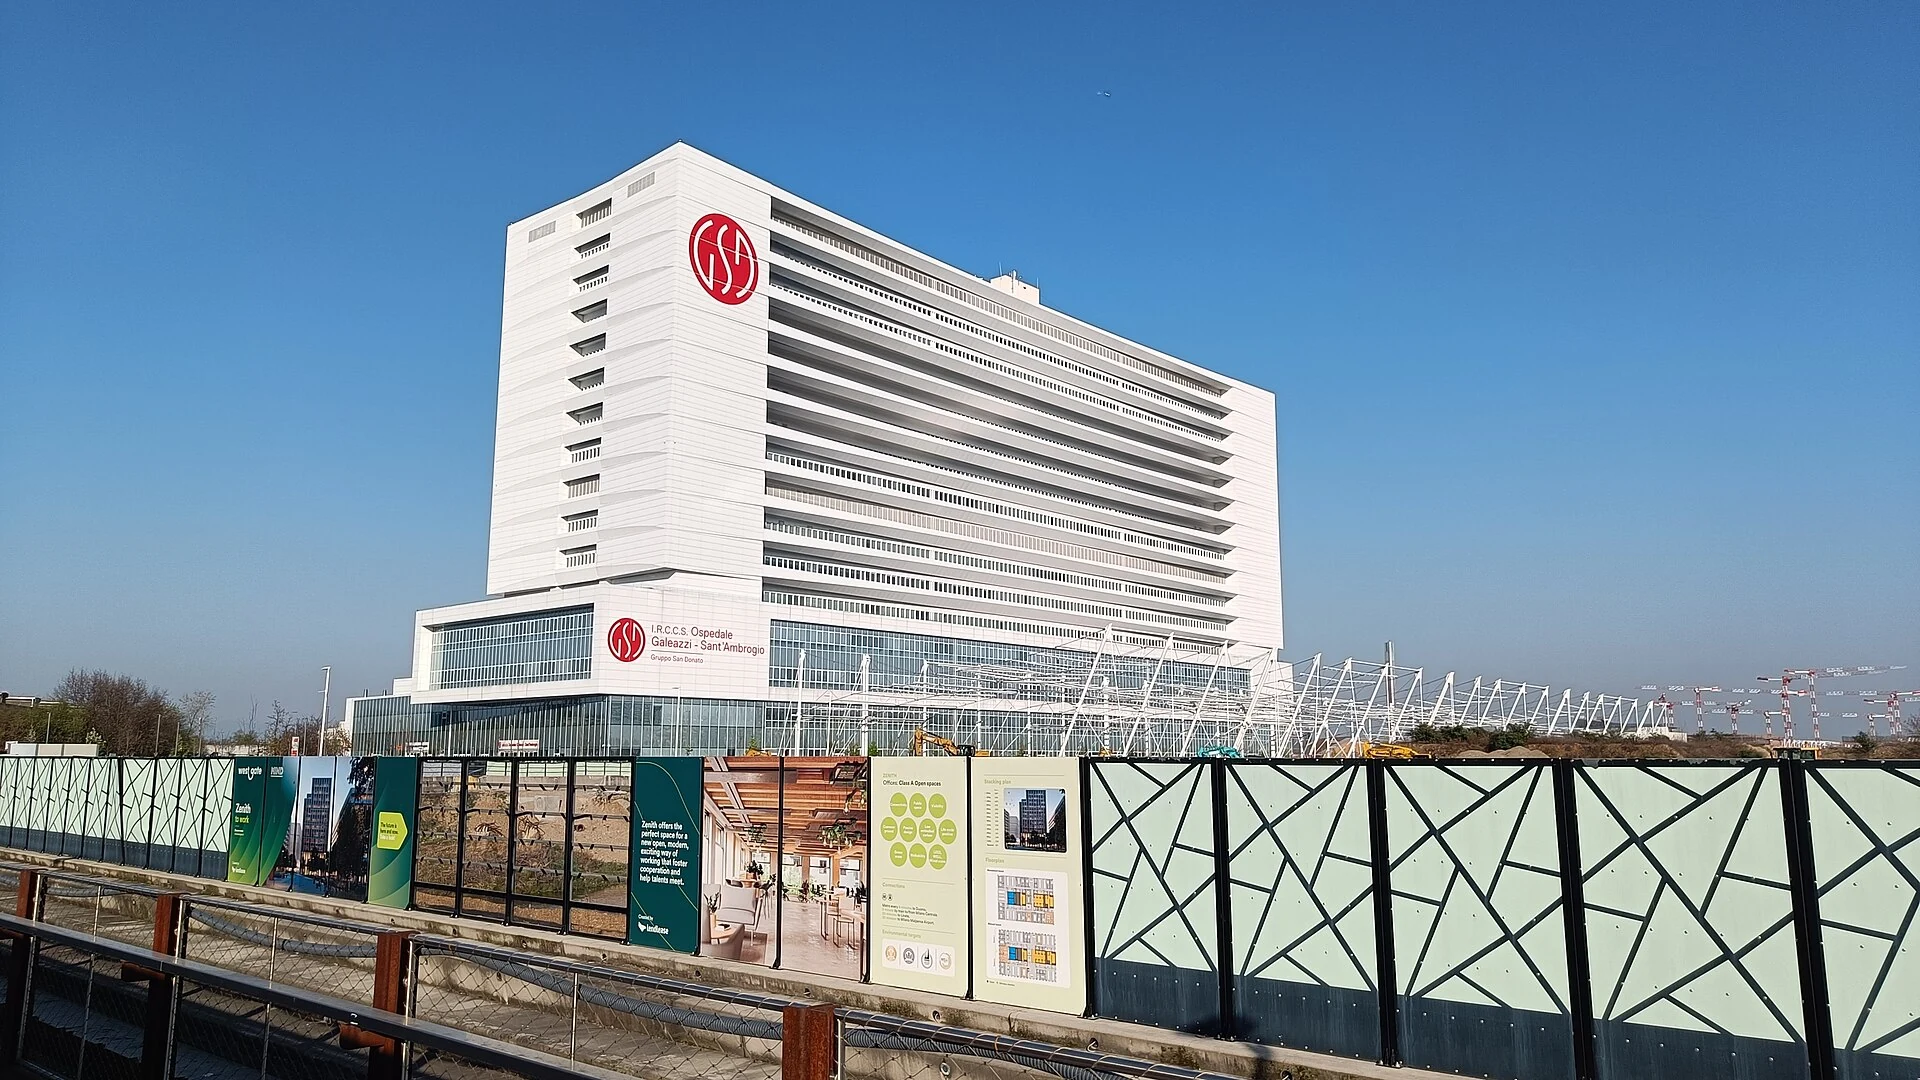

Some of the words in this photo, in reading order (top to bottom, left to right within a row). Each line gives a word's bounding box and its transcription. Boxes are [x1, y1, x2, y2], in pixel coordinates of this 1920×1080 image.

[651, 624, 689, 637] I.R.C.C.S.
[690, 626, 733, 639] Ospedale
[651, 636, 692, 649] Galeazzi
[700, 640, 765, 656] Sant'Ambrogio
[650, 653, 672, 662] Gruppo
[672, 655, 684, 663] San
[684, 656, 704, 664] Donato
[235, 803, 252, 814] Zenith
[240, 815, 250, 823] work
[641, 820, 657, 830] Zenith
[658, 821, 673, 830] offers
[674, 822, 682, 830] the
[641, 830, 660, 839] perfect
[660, 832, 675, 840] space
[675, 831, 684, 840] for
[652, 841, 667, 849] open,
[667, 841, 689, 850] modern,
[640, 848, 660, 857] exciting
[660, 850, 672, 858] way
[672, 849, 679, 857] of
[640, 857, 661, 866] working
[661, 858, 672, 866] that
[672, 858, 689, 867] foster
[640, 866, 670, 876] cooperation
[670, 868, 681, 876] and
[639, 874, 651, 884] help
[651, 875, 669, 884] talents
[669, 877, 685, 885] meet.
